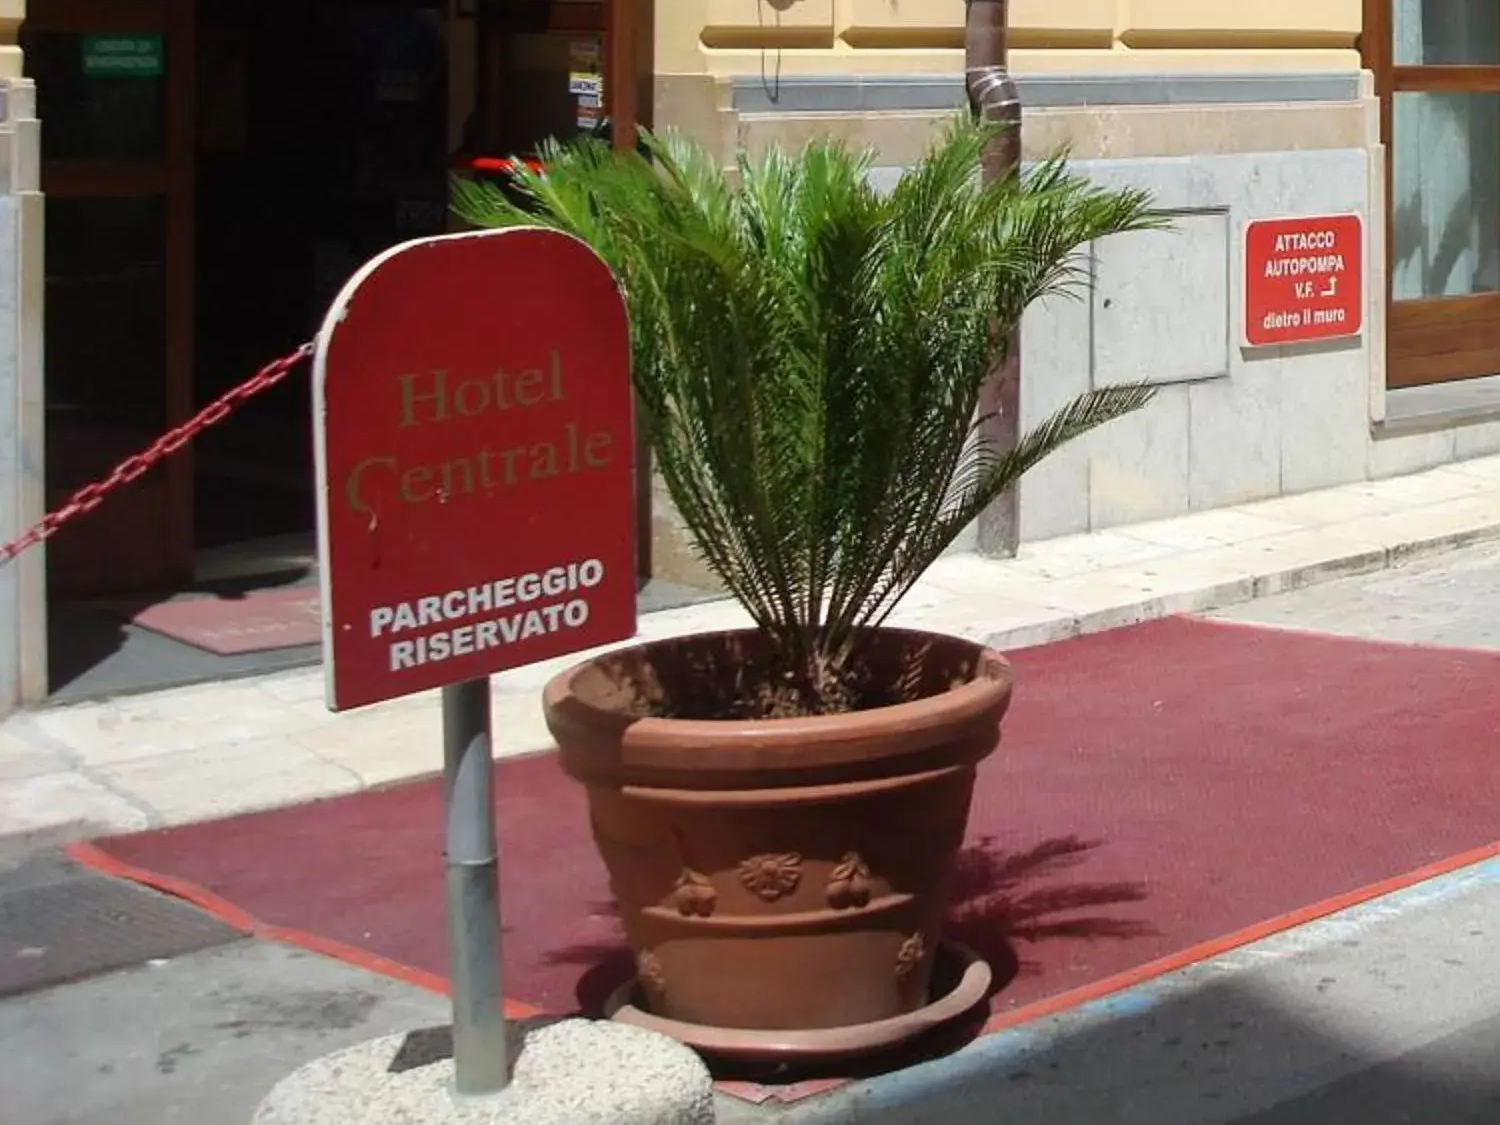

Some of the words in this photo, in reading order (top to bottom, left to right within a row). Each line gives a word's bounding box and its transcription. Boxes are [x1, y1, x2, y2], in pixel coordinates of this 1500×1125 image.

[1275, 230, 1335, 252] ATTACCO
[1264, 254, 1345, 278] AUTOPOMPA
[1295, 281, 1315, 300] V.F.
[1263, 311, 1301, 330] dietro
[1303, 307, 1311, 325] il
[1314, 308, 1345, 323] muro
[398, 350, 567, 428] Hotel
[345, 423, 613, 513] Centrale
[370, 558, 604, 637] PARCHEGGIO
[390, 599, 590, 671] RISERVATO
